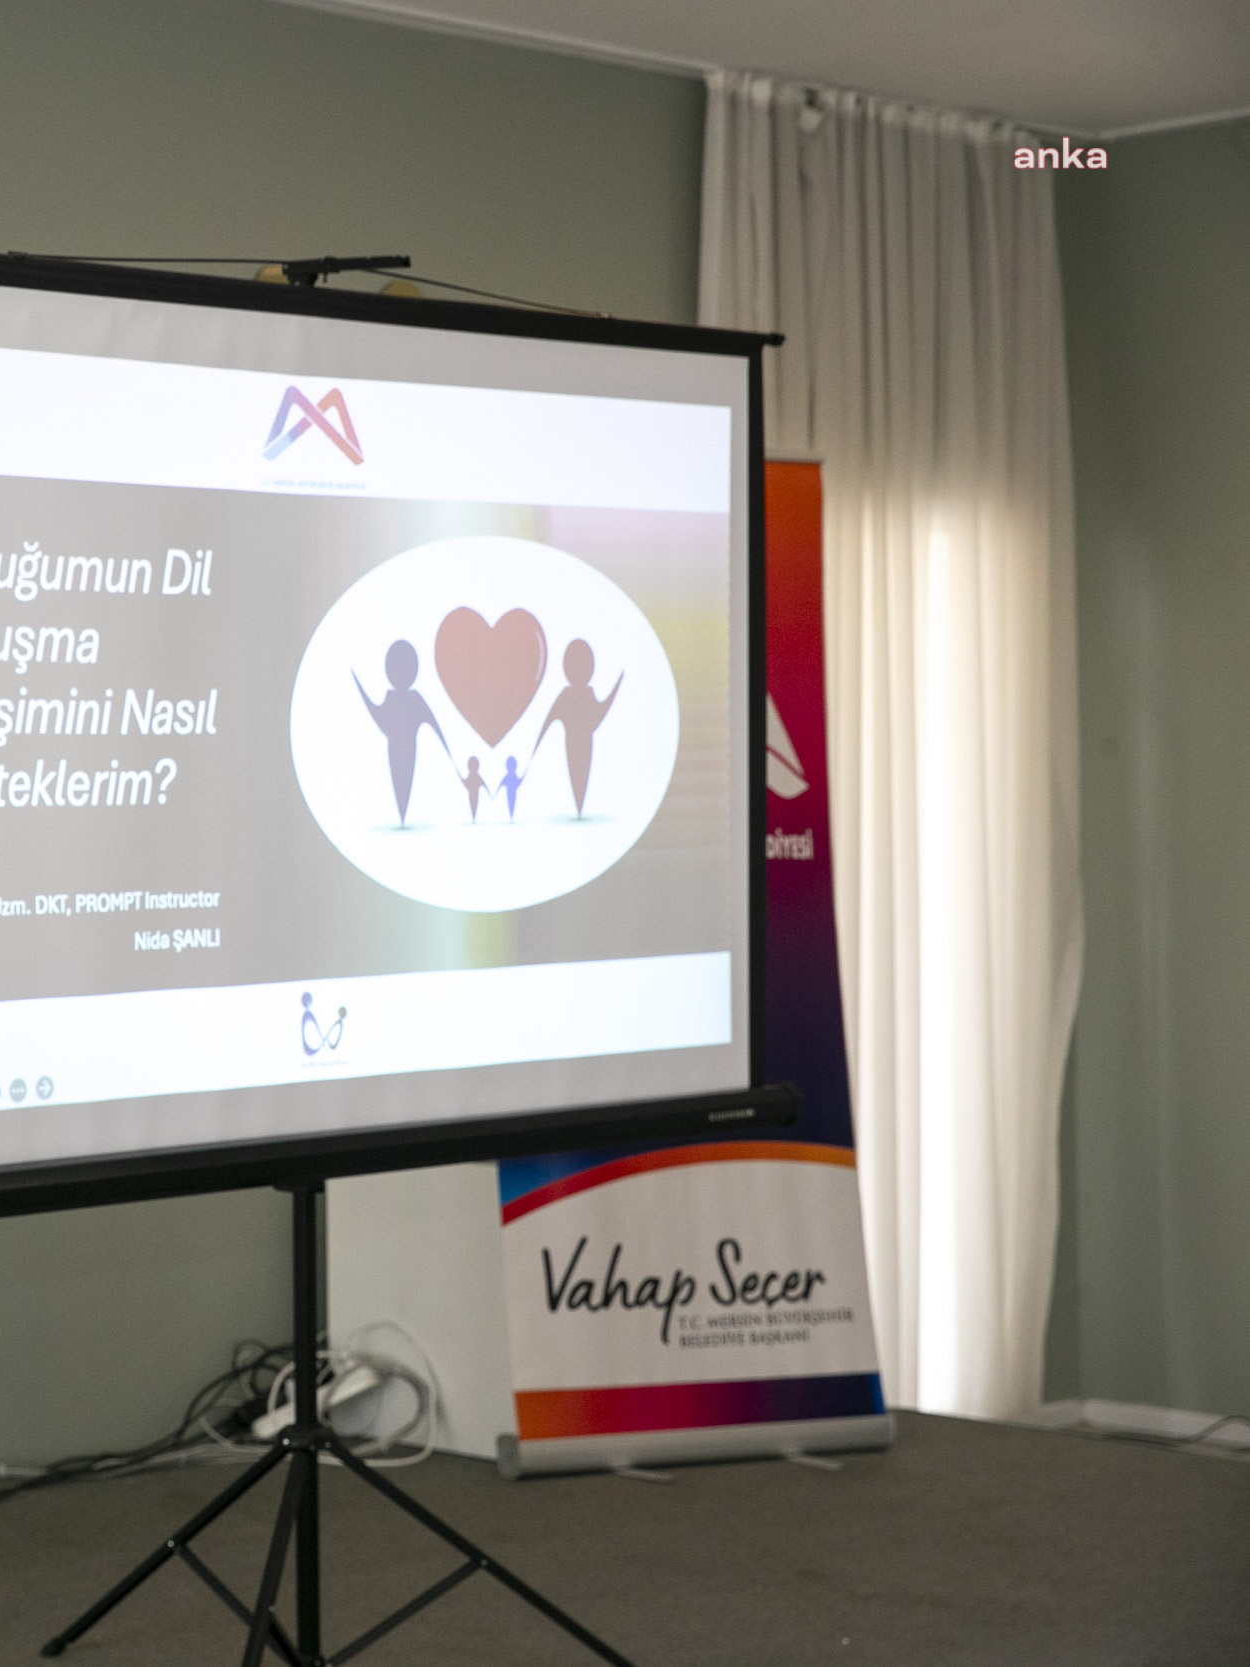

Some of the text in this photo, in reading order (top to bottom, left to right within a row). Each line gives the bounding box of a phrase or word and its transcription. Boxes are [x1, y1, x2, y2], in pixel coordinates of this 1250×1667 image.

[162, 548, 213, 596] Dil
[120, 688, 218, 735] Nasıl
[35, 894, 72, 917] DKT,
[75, 891, 143, 913] PROMPT
[145, 890, 221, 910] Instructor
[134, 928, 221, 953] Nida ŞANLI
[541, 1235, 826, 1346] Vahap Seçer
